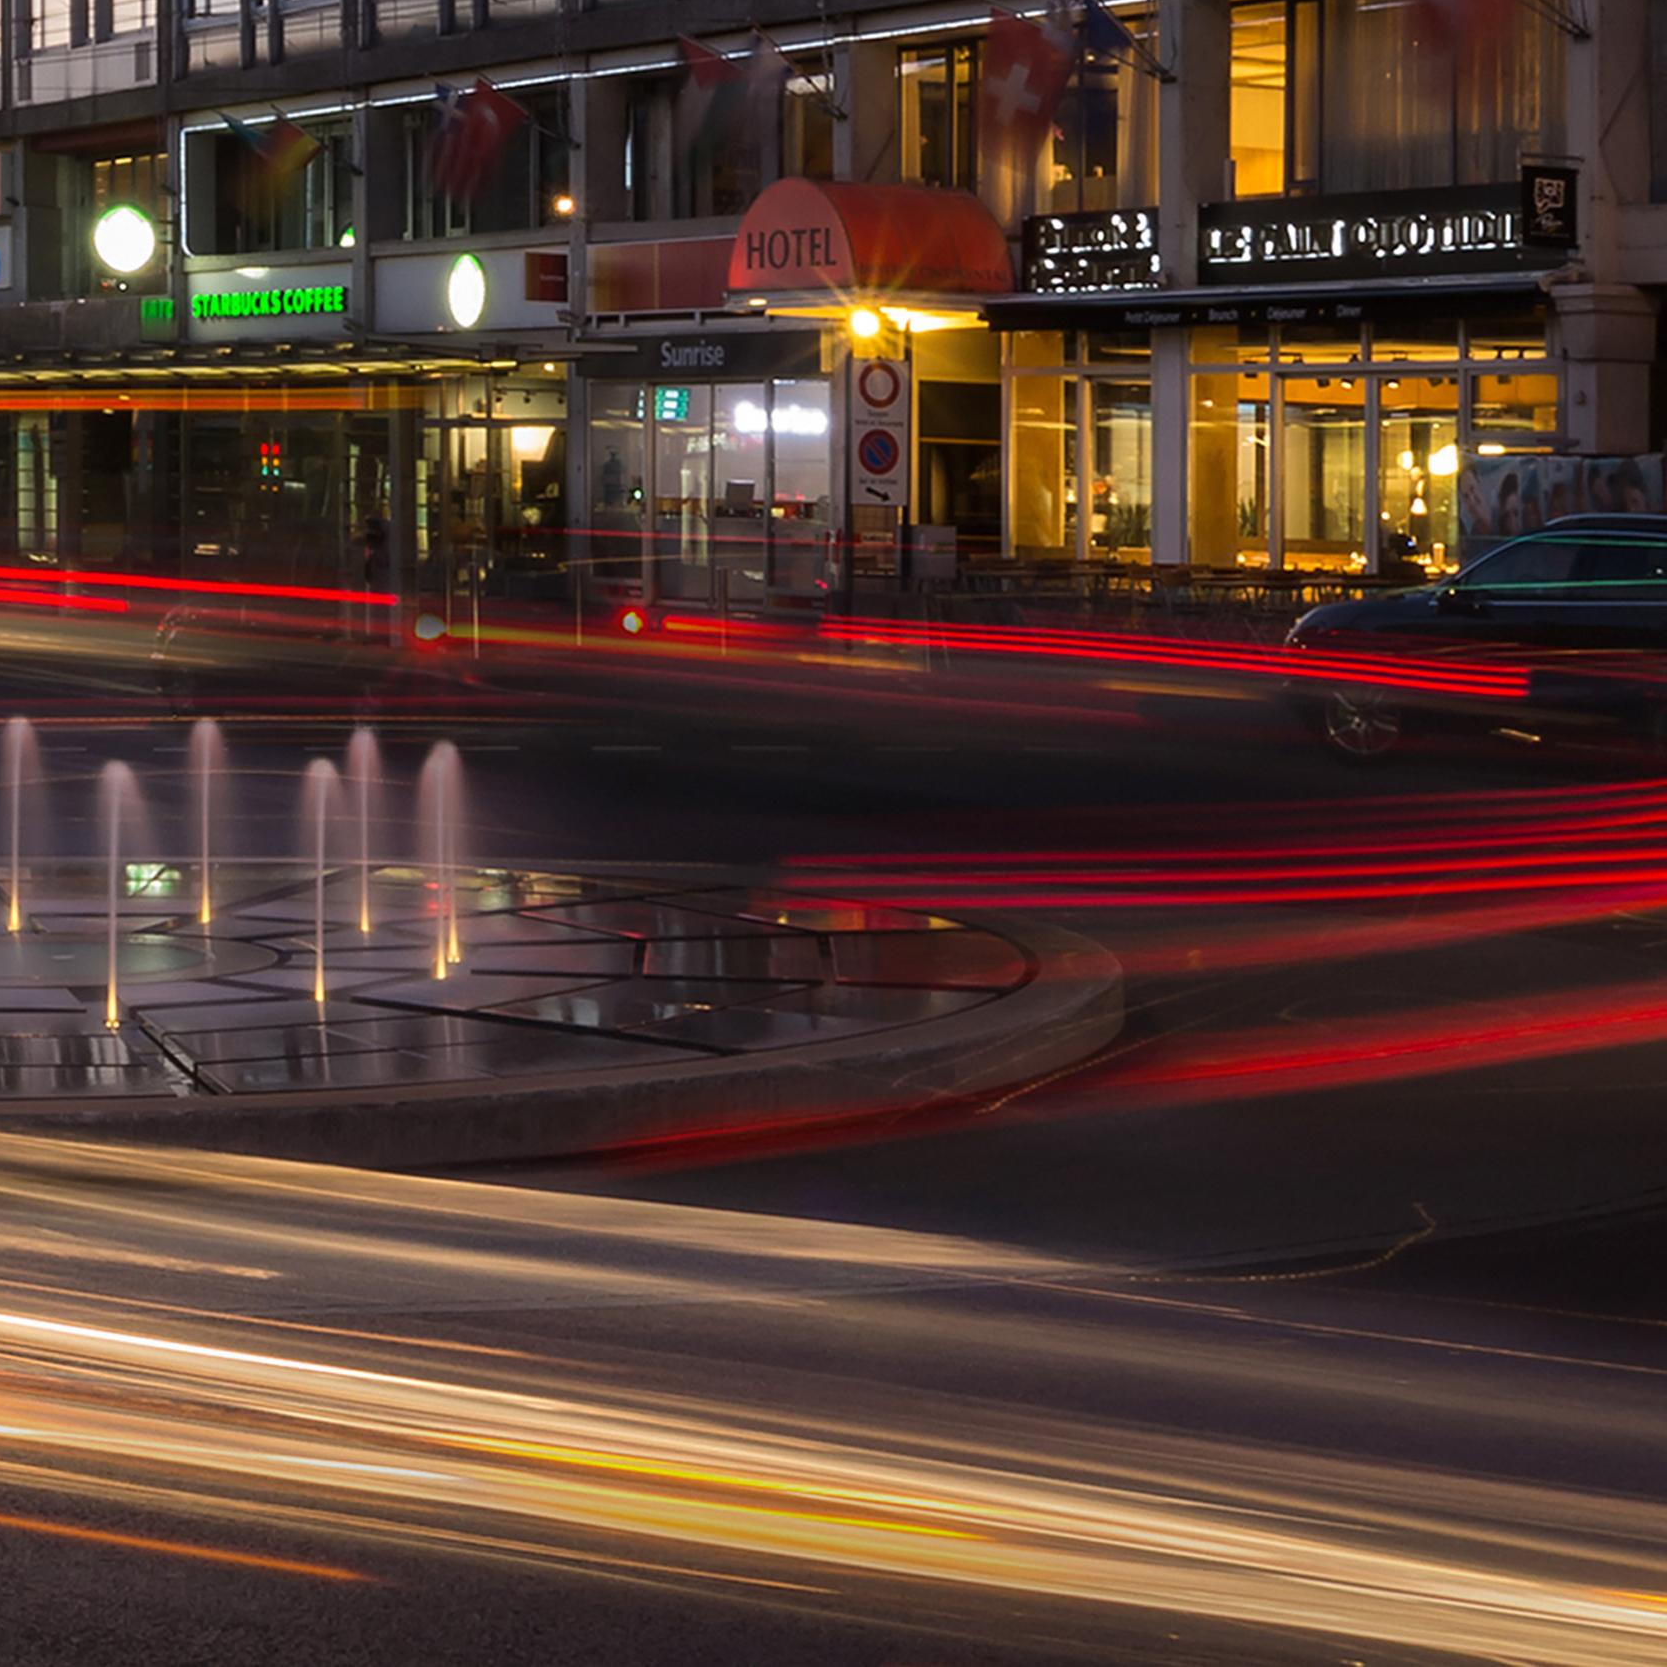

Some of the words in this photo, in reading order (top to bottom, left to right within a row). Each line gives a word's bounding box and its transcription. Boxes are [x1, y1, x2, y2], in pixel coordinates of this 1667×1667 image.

[746, 227, 837, 270] HOTEL
[191, 291, 282, 318] STARBUCKS
[282, 286, 344, 314] COFFEE
[660, 339, 726, 367] Sunrise
